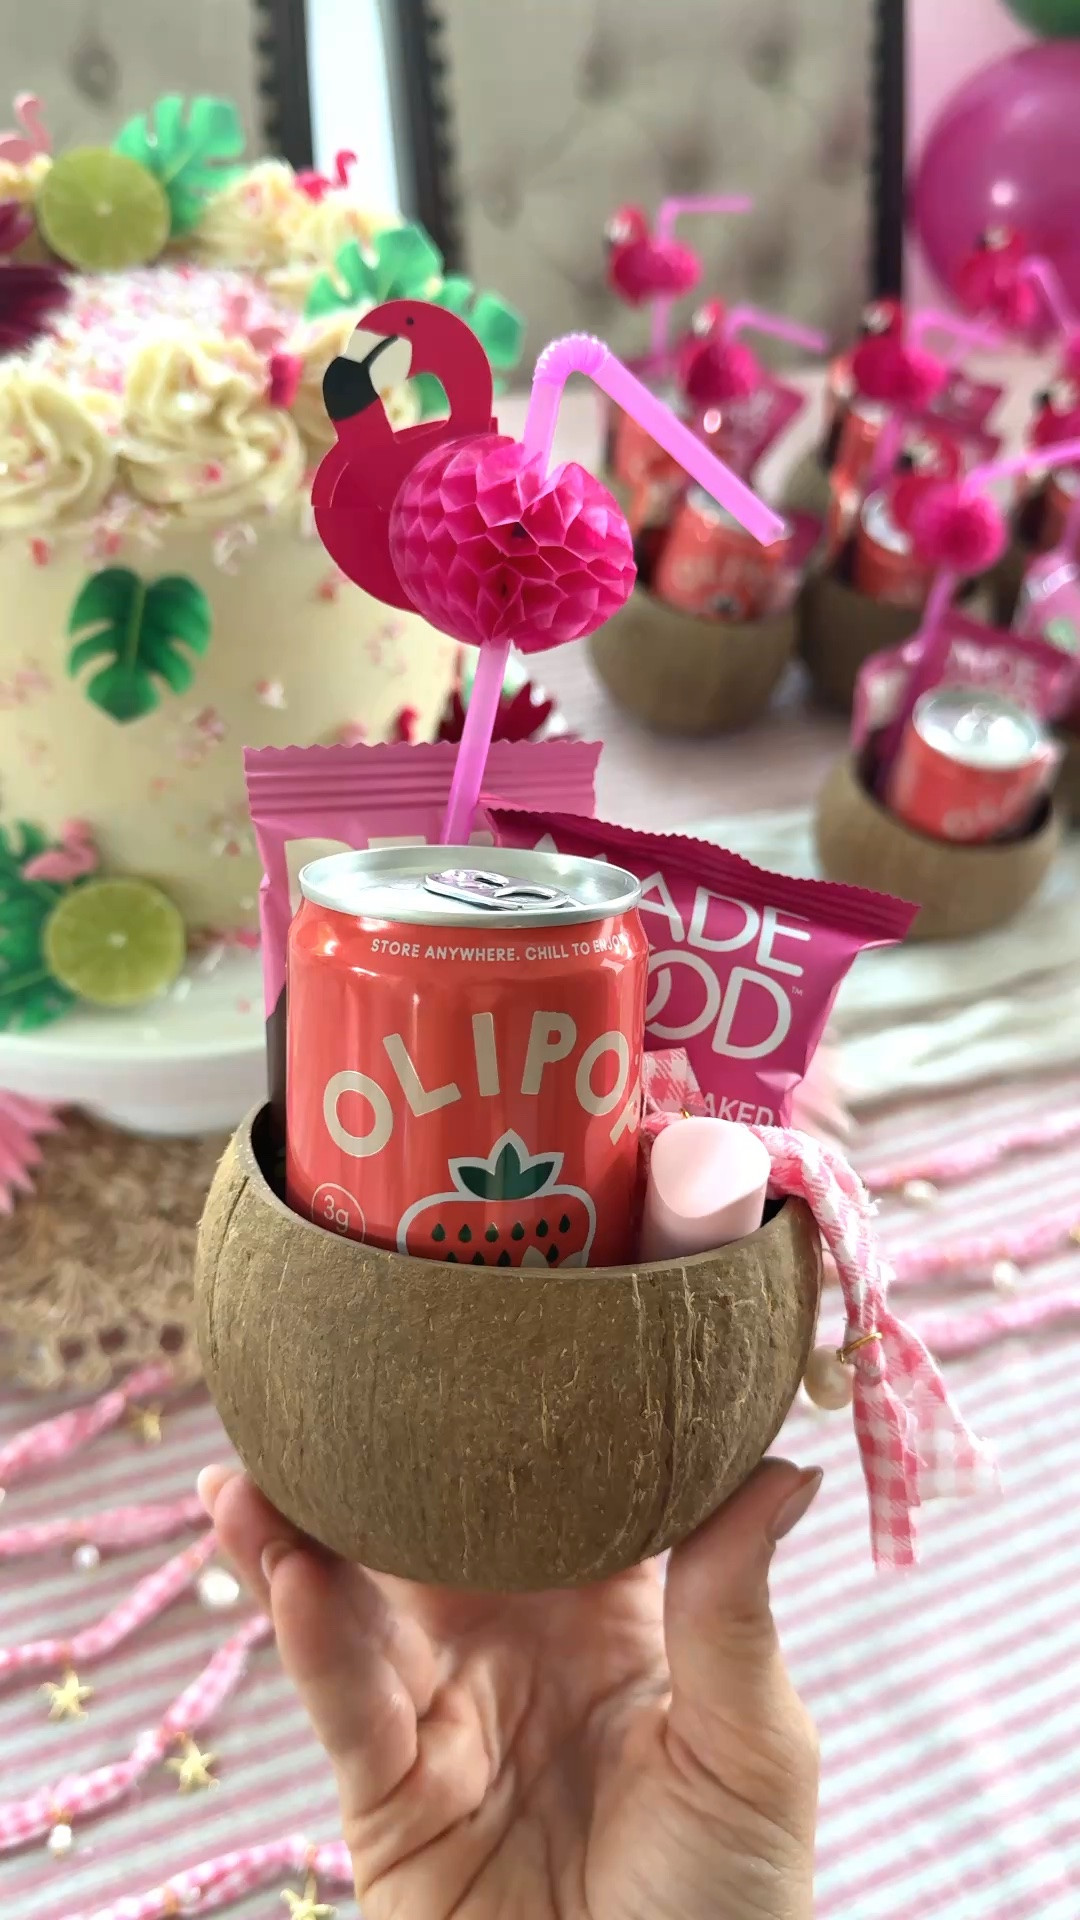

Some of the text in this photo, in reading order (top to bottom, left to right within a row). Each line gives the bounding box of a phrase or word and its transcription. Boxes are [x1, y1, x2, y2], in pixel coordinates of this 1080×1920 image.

[590, 852, 811, 977] ADE
[371, 938, 420, 958] STORE
[424, 946, 520, 962] ANYWHERE.
[525, 945, 569, 961] CHILL
[571, 942, 590, 956] TO
[645, 945, 792, 1060] OD
[704, 1091, 775, 1127] AKED
[323, 1194, 349, 1234] 3g
